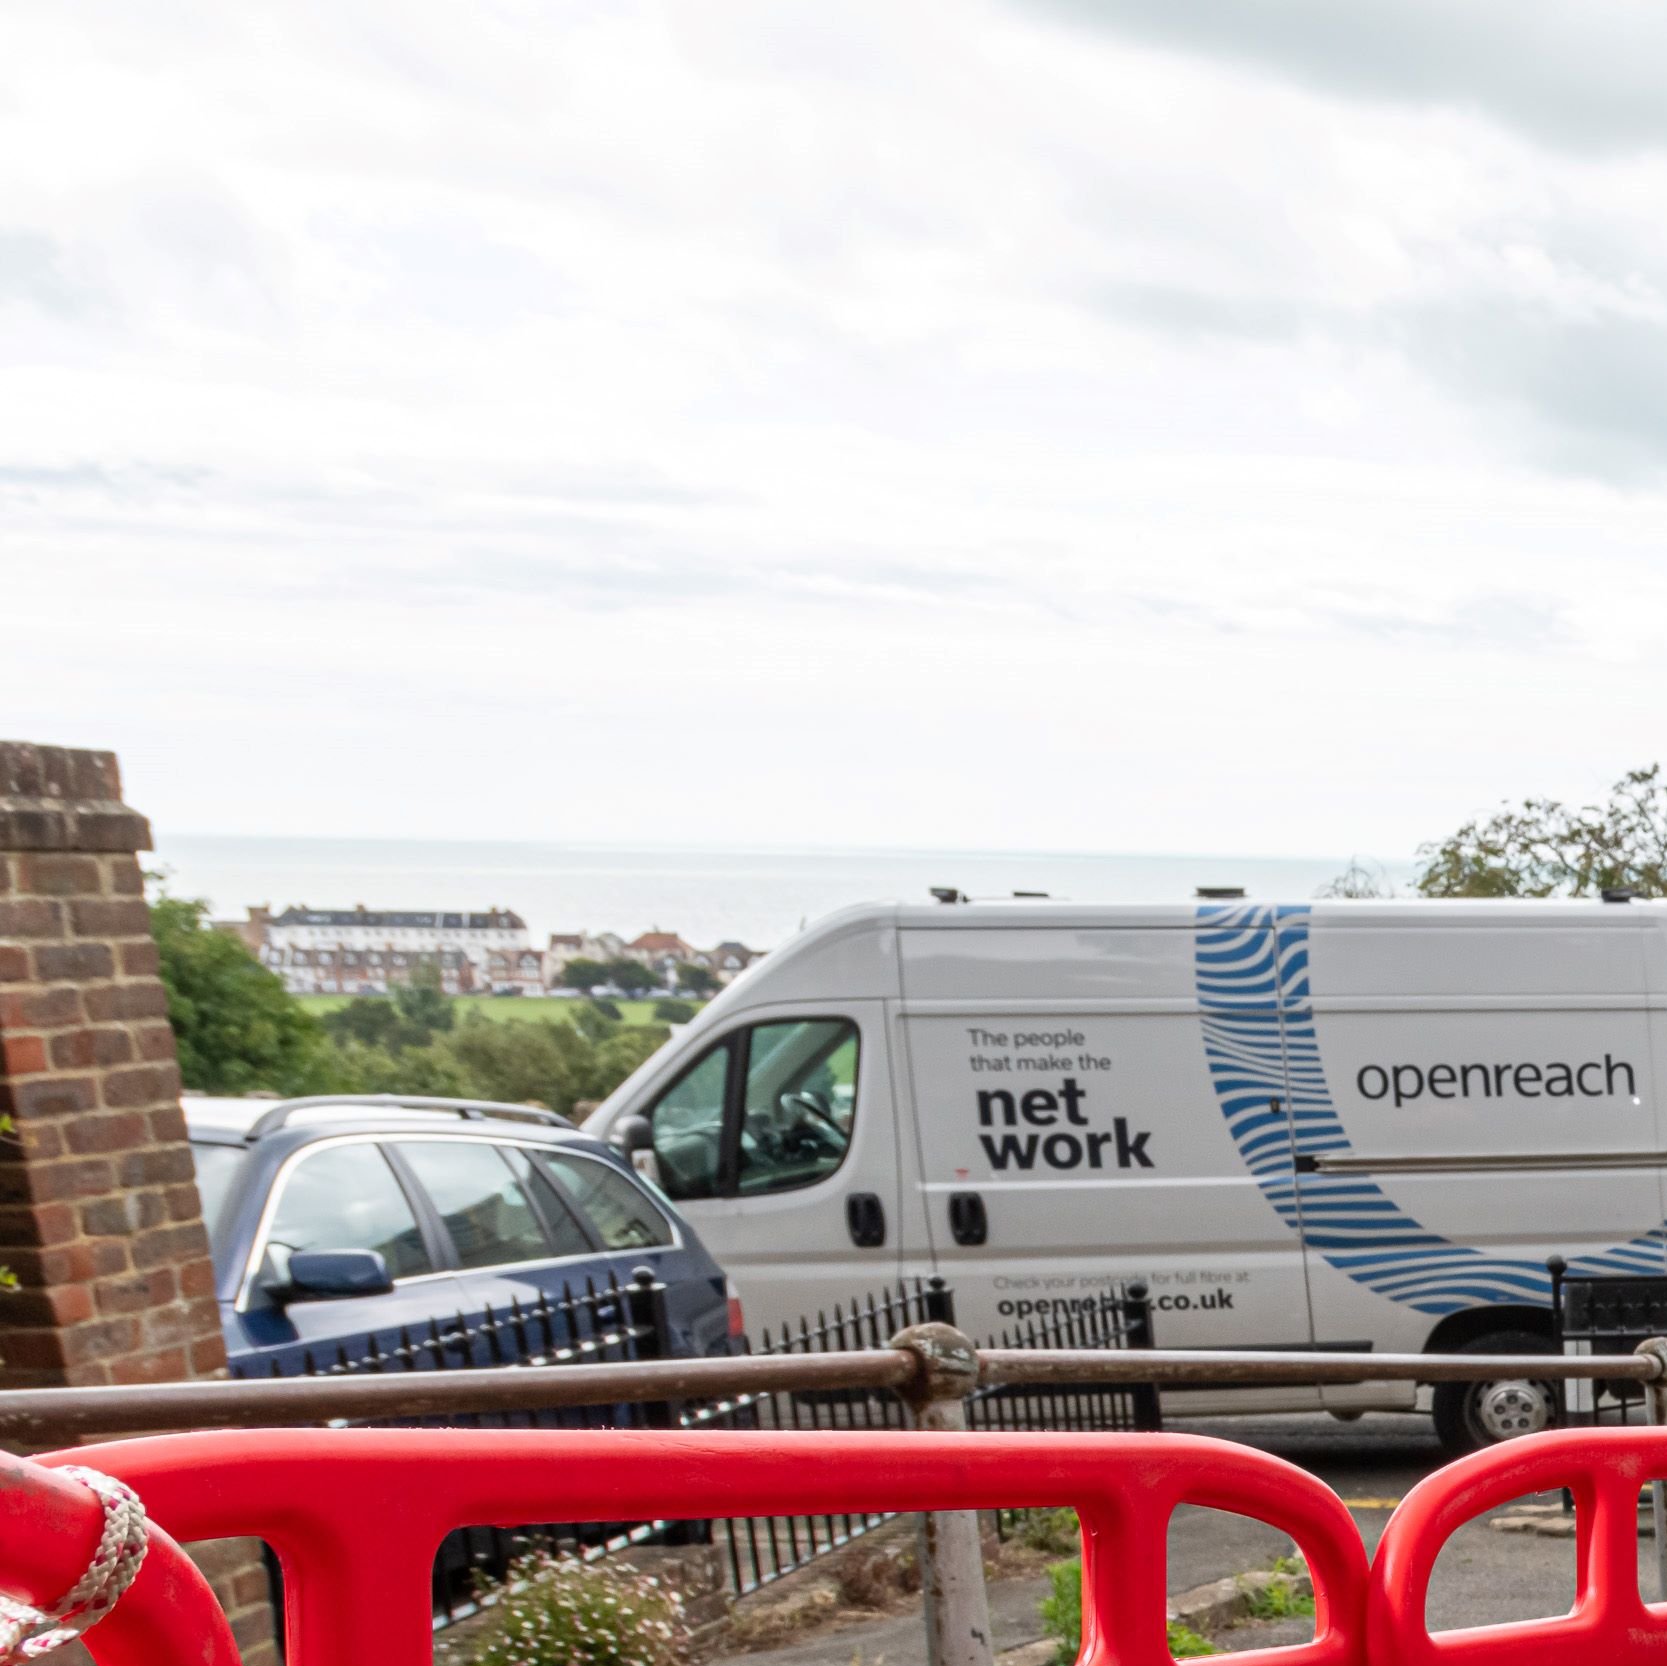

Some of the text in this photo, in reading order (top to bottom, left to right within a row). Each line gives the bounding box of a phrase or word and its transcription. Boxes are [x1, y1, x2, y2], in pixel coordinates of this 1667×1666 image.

[966, 1028, 1085, 1050] The people
[969, 1054, 1112, 1072] that make the
[1356, 1053, 1636, 1108] openreach
[976, 1077, 1089, 1127] net
[977, 1116, 1156, 1171] work
[993, 1275, 1035, 1290] Check
[1042, 1277, 1076, 1292] your
[1151, 1272, 1171, 1285] for
[1175, 1271, 1198, 1284] full
[1200, 1270, 1232, 1284] fibre
[1234, 1270, 1249, 1284] at
